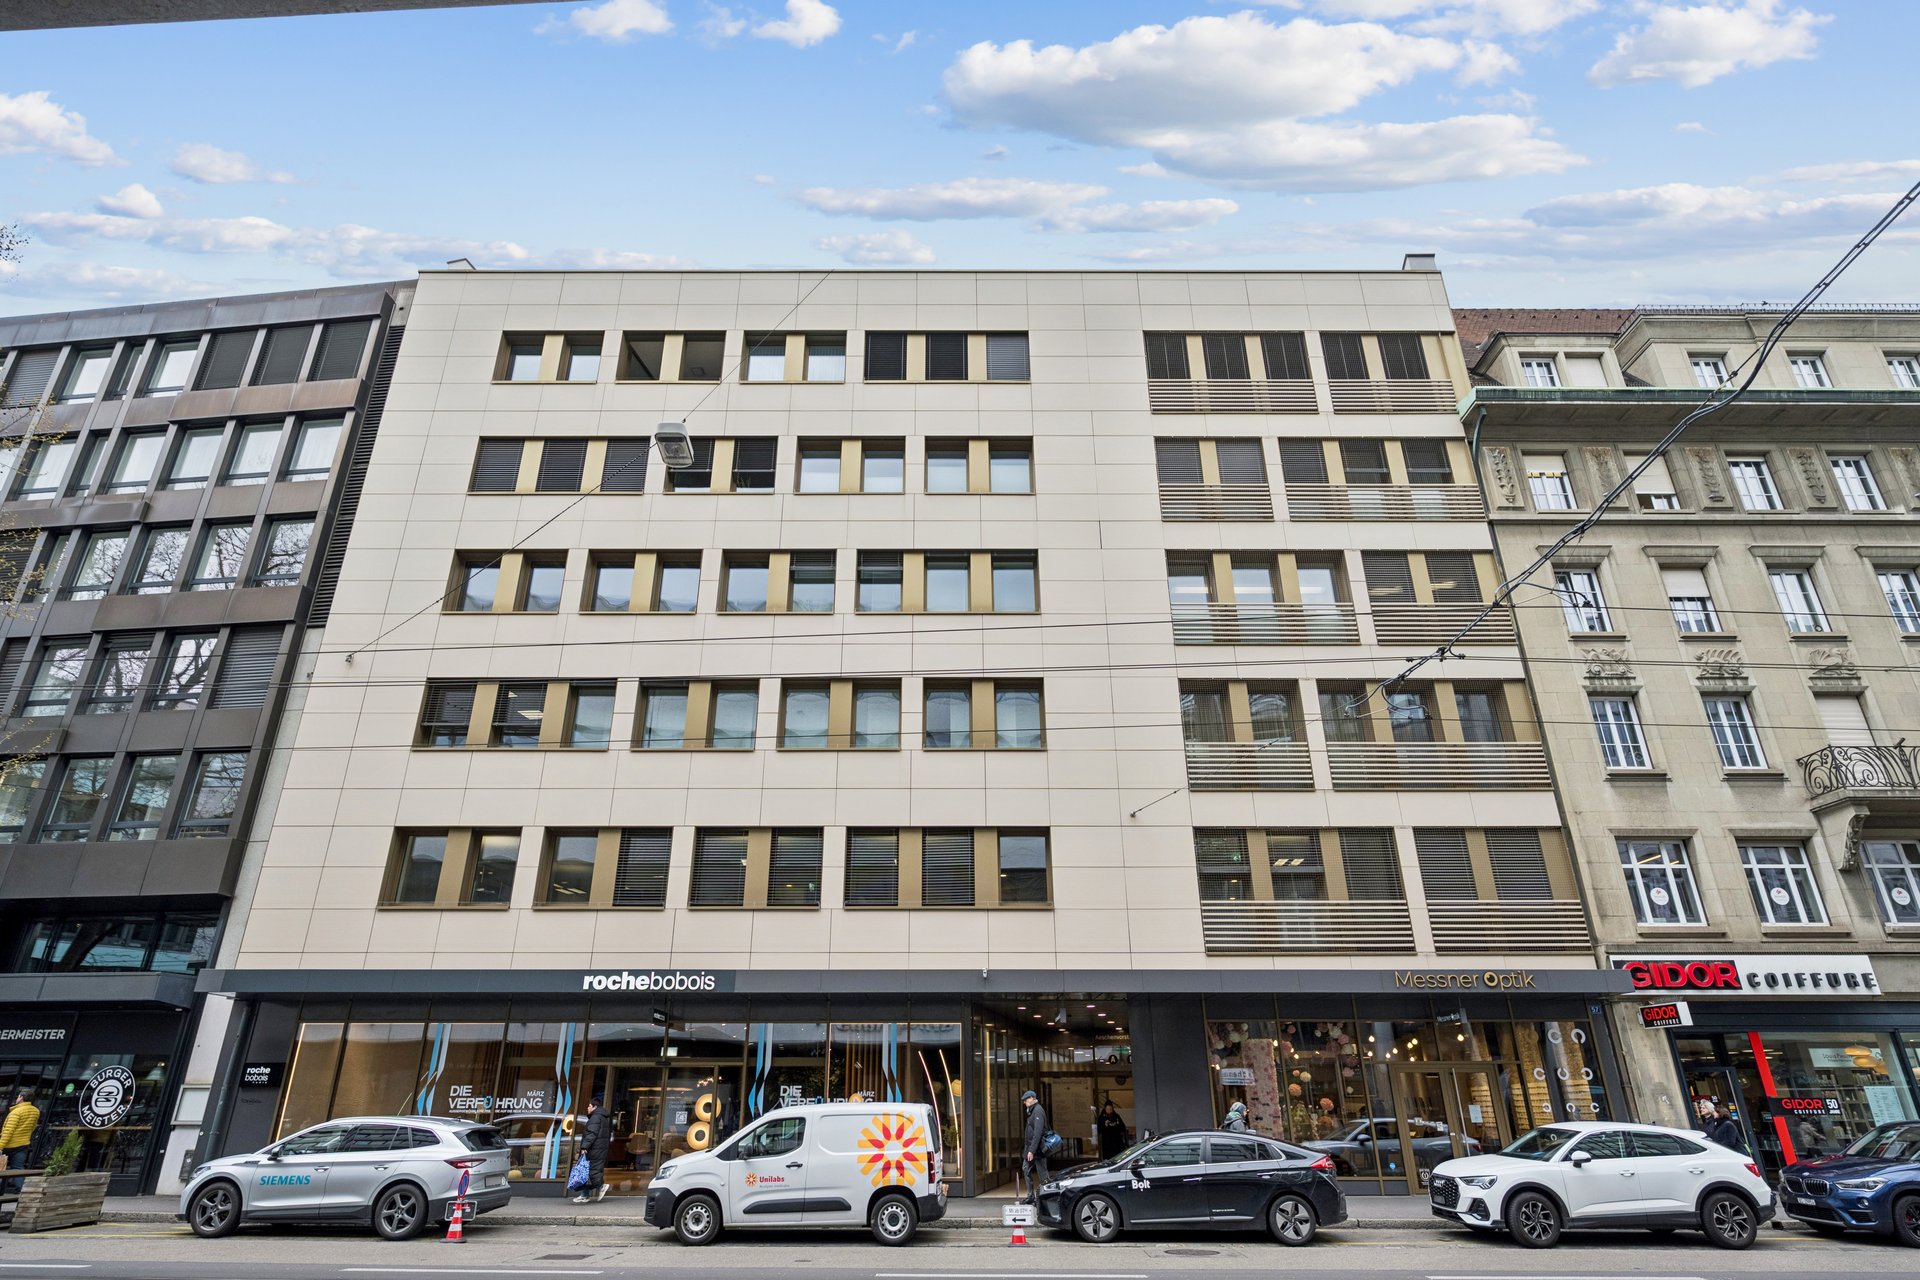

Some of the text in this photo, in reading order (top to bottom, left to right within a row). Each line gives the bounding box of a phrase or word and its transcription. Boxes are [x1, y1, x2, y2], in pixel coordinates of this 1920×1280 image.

[1394, 970, 1536, 991] Messner Optik
[1622, 961, 1877, 990] GIDOR COIFFURE
[1643, 1005, 1678, 1021] GIDOR
[0, 1029, 66, 1040] ERMEISTER
[246, 1066, 271, 1074] roche
[90, 1068, 132, 1089] BURGER
[244, 1073, 269, 1082] bobois
[449, 1085, 473, 1097] DIE
[780, 1085, 803, 1097] DIE
[1781, 1098, 1824, 1109] GIDOR
[1825, 1098, 1839, 1109] 50
[81, 1104, 126, 1127] MEISTER
[259, 1175, 311, 1186] SIEMENS
[759, 1175, 785, 1183] Unilabs
[1131, 1179, 1151, 1192] Bolt
